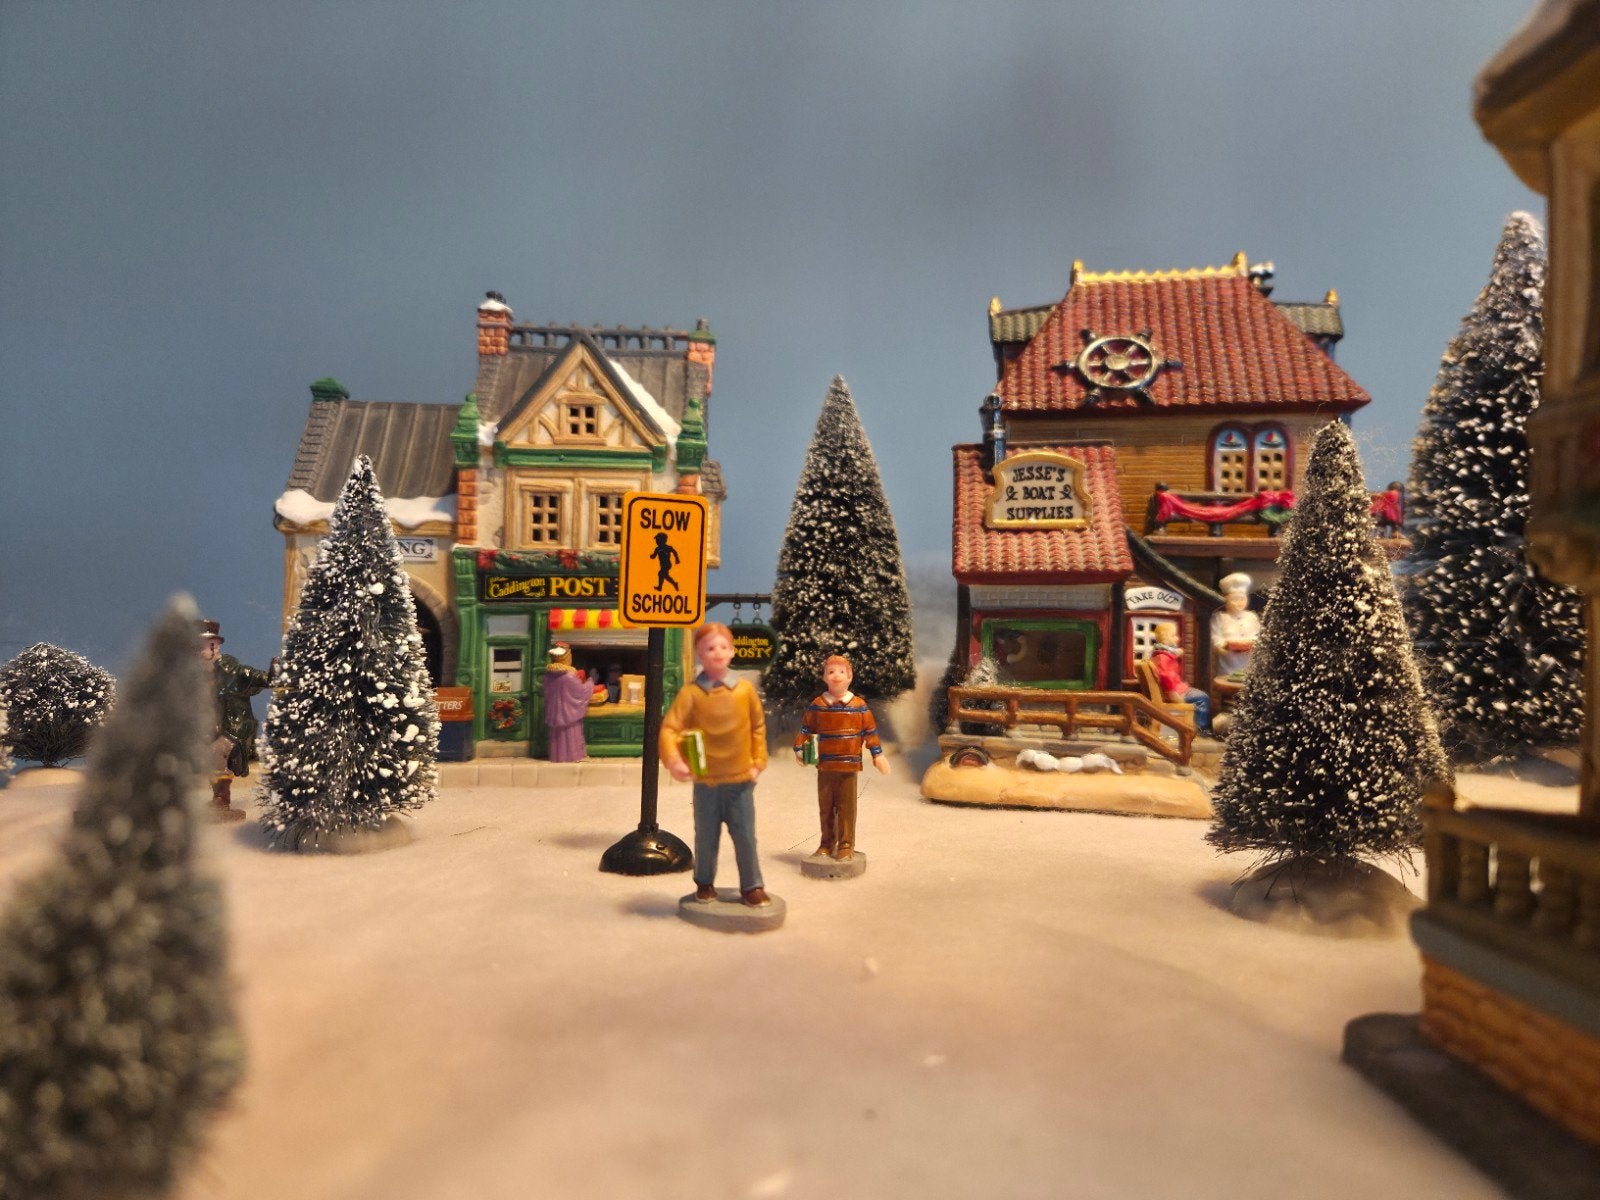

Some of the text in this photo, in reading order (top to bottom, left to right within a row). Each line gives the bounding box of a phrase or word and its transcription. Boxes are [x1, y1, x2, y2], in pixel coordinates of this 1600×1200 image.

[1012, 465, 1066, 482] JESSE'S
[1022, 486, 1056, 500] BOAT
[640, 508, 691, 531] SLOW
[1006, 506, 1074, 520] SUPPLIES
[397, 541, 425, 555] NG
[550, 577, 611, 597] POST
[632, 593, 692, 614] SCHOOL
[1127, 591, 1180, 604] TAKE OUT
[732, 635, 769, 648] addington
